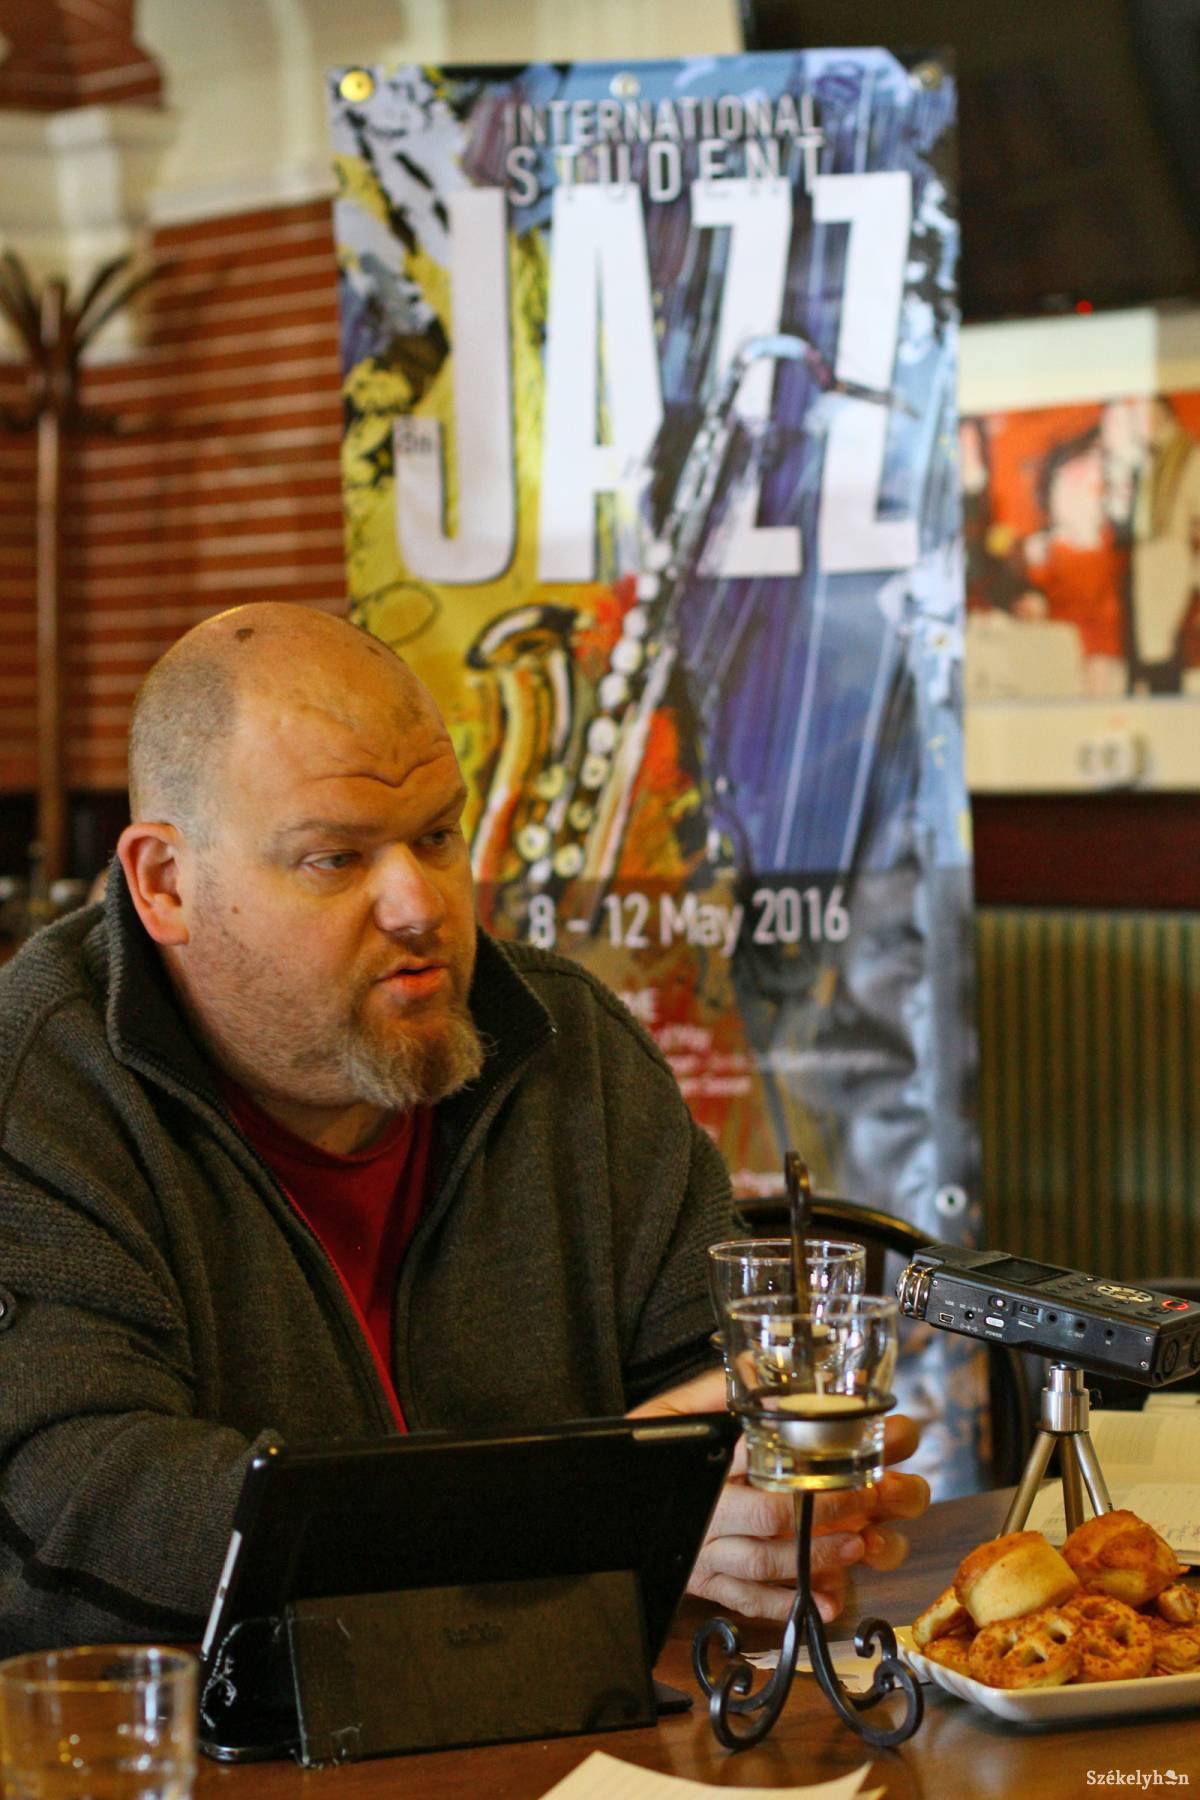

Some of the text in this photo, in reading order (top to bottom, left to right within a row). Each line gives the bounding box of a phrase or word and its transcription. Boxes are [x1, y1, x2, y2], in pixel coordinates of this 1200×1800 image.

[504, 96, 823, 146] INTERNATIONAL
[505, 138, 826, 207] STUDENT
[394, 171, 920, 583] JAZZ
[528, 894, 557, 950] 8
[605, 891, 650, 949] 12
[659, 891, 745, 960] May
[753, 886, 850, 944] 2016
